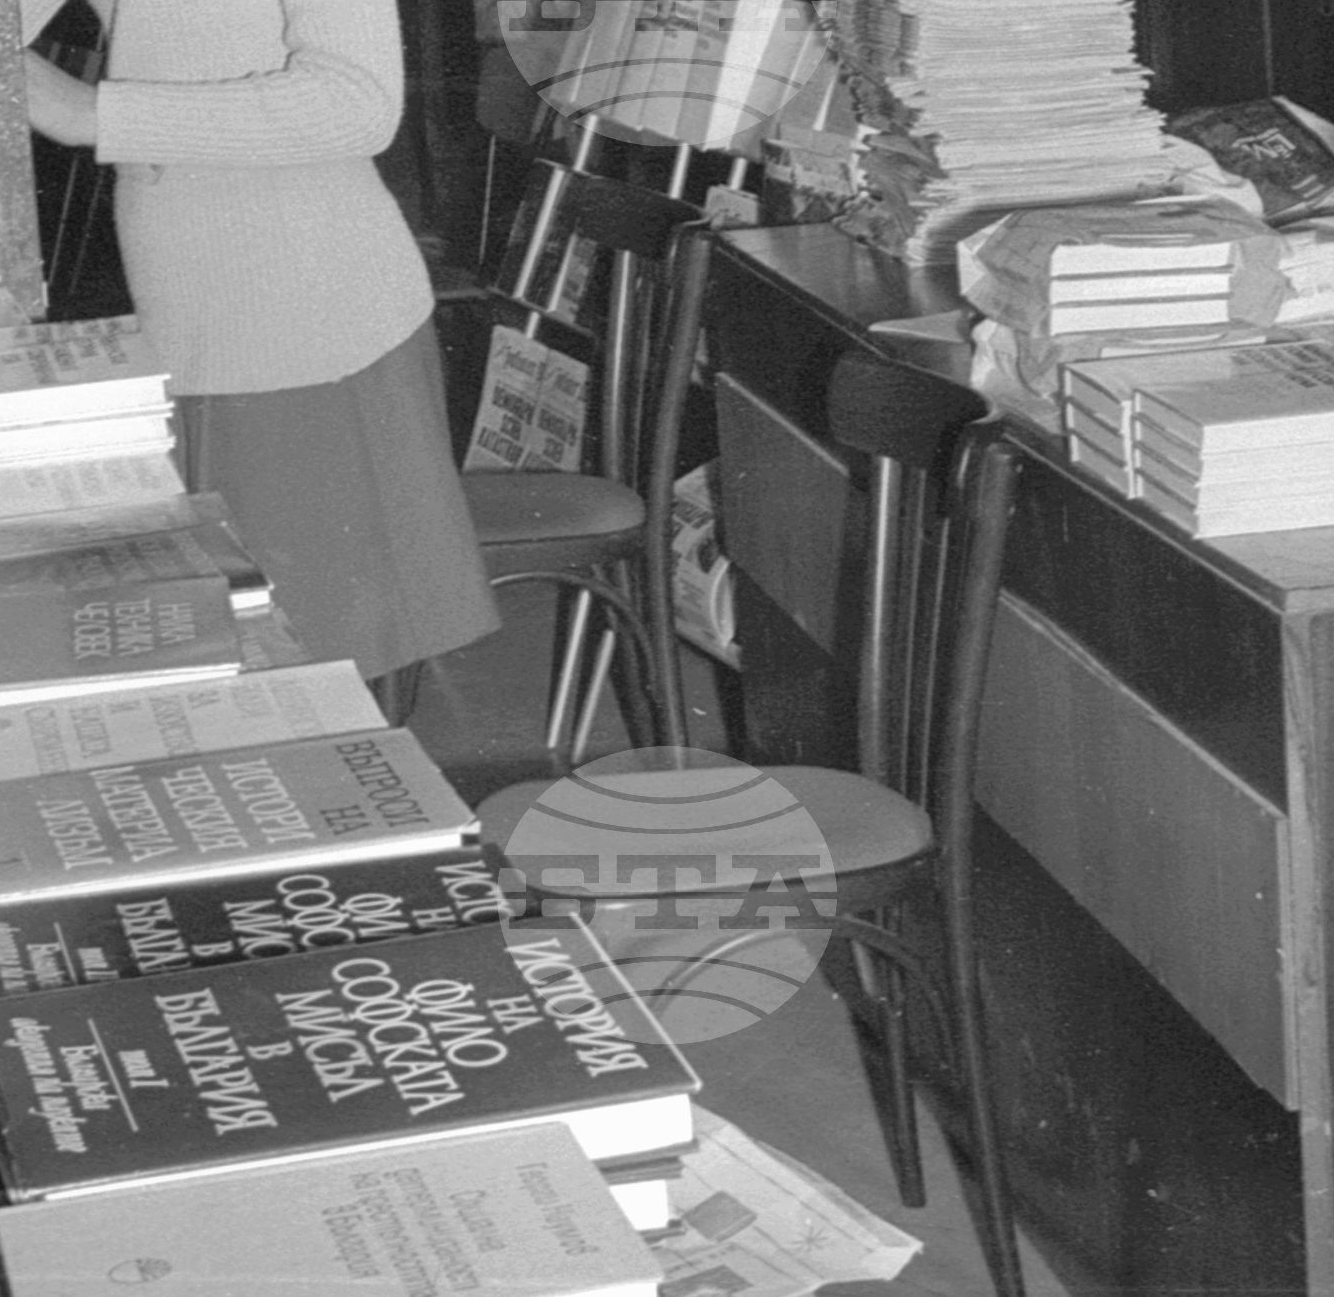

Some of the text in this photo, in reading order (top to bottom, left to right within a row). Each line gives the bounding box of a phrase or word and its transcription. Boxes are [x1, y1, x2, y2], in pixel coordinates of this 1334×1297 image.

[115, 599, 155, 656] ТЕХНИКА
[157, 602, 196, 646] НАУКА
[88, 766, 179, 863] МАТЕРИА
[161, 765, 249, 853] ЧЕСКИЯ
[221, 757, 315, 844] ИСТОРИ
[320, 804, 371, 836] НА
[335, 739, 430, 828] ВЪПРОСИ
[37, 800, 114, 870] ЛИЗЪМ
[117, 897, 191, 974] БЪЛГА
[191, 940, 233, 957] В
[339, 893, 409, 938] ФИ
[412, 906, 458, 928] Н
[331, 958, 465, 1115] СОФСКАТА
[403, 979, 508, 1067] ФИЛО
[486, 994, 544, 1034] НА
[504, 937, 649, 1078] ИСТОРИЯ
[118, 1049, 156, 1078] том
[154, 987, 278, 1136] БЪЛГАРИЯ
[246, 1040, 293, 1060] В
[275, 989, 384, 1103] МИСЪЛ
